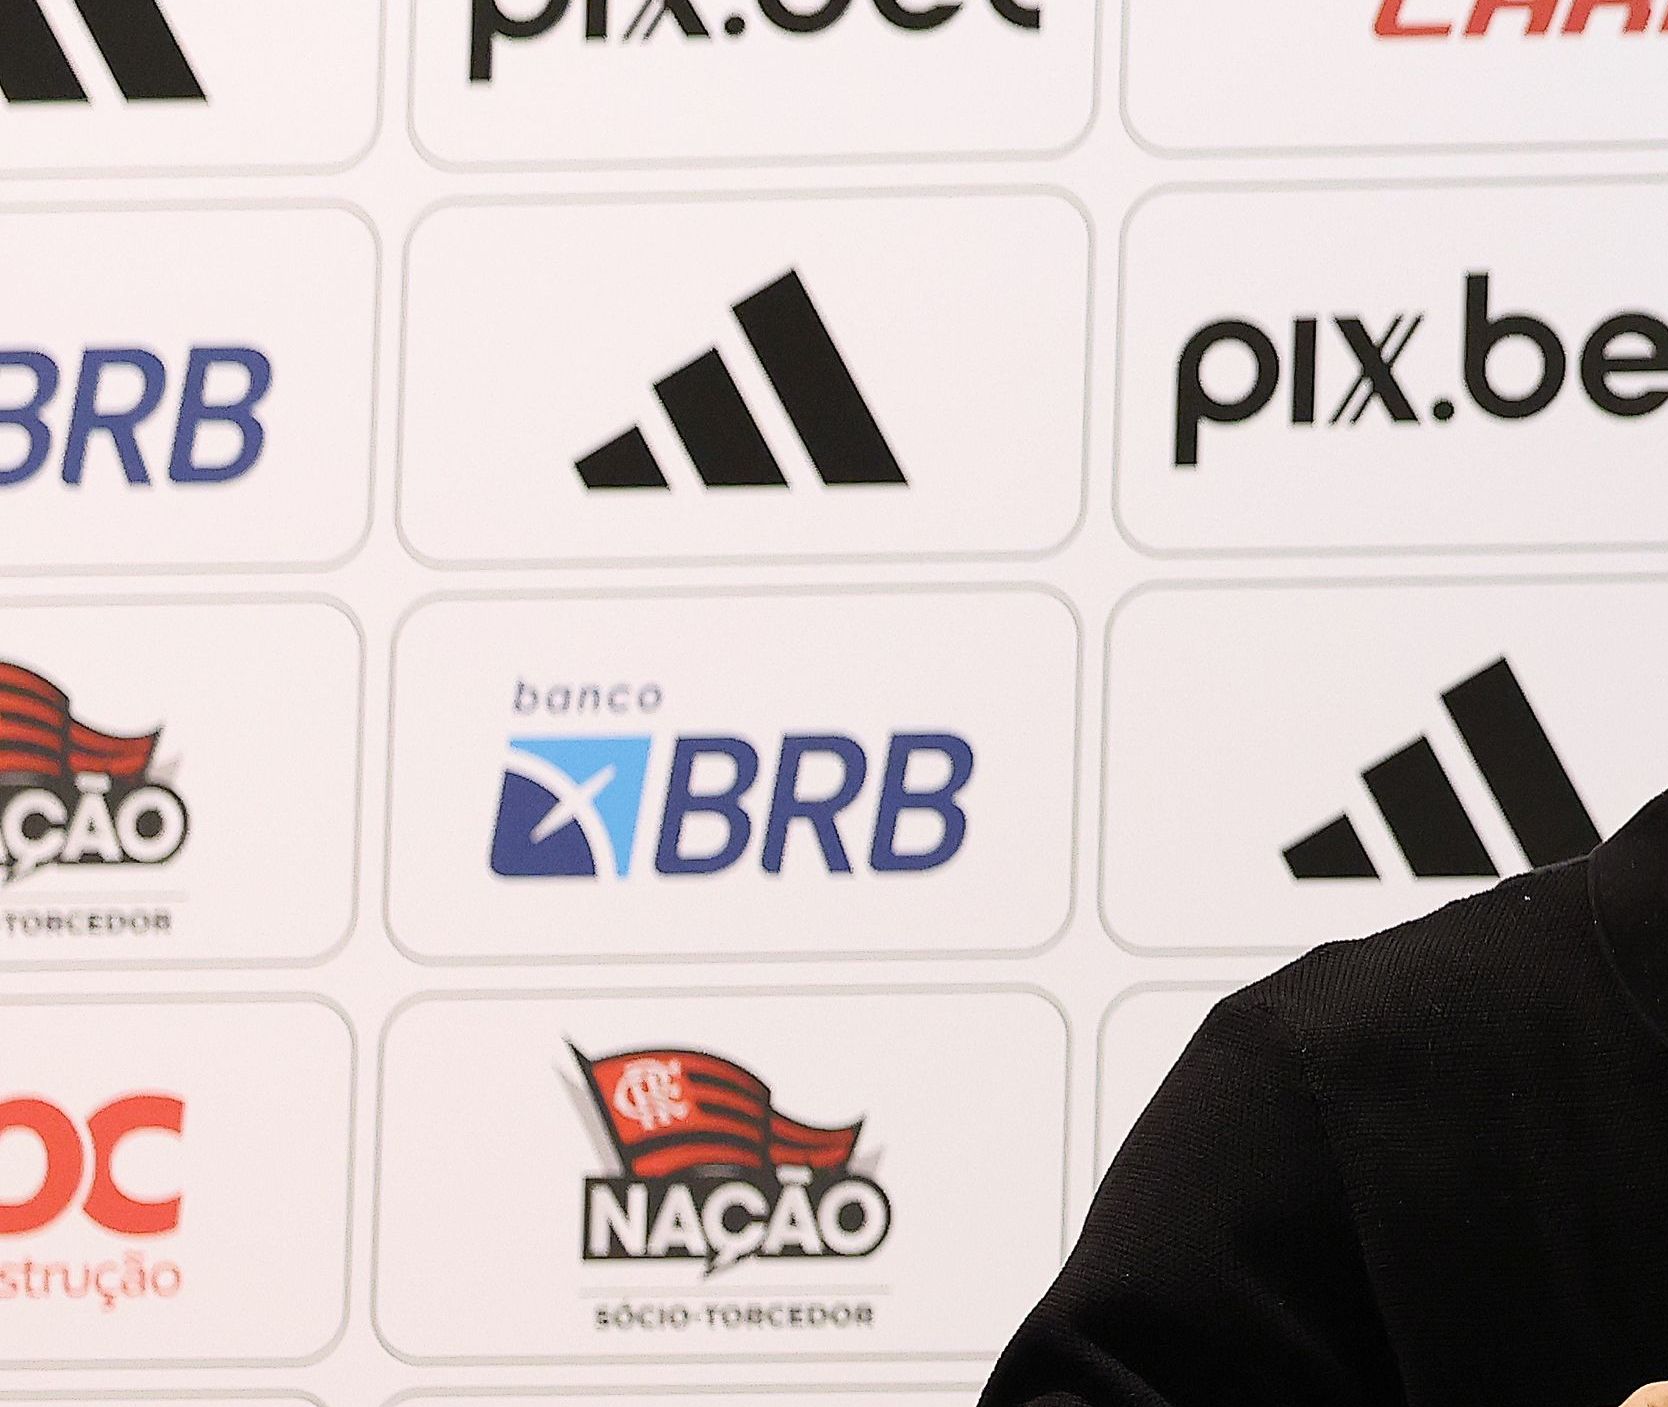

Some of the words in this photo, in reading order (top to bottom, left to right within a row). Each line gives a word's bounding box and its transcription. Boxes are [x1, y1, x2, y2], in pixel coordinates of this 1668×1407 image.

[514, 681, 662, 712] banco
[654, 733, 974, 876] BRB
[588, 1168, 892, 1270] NAÇÃO
